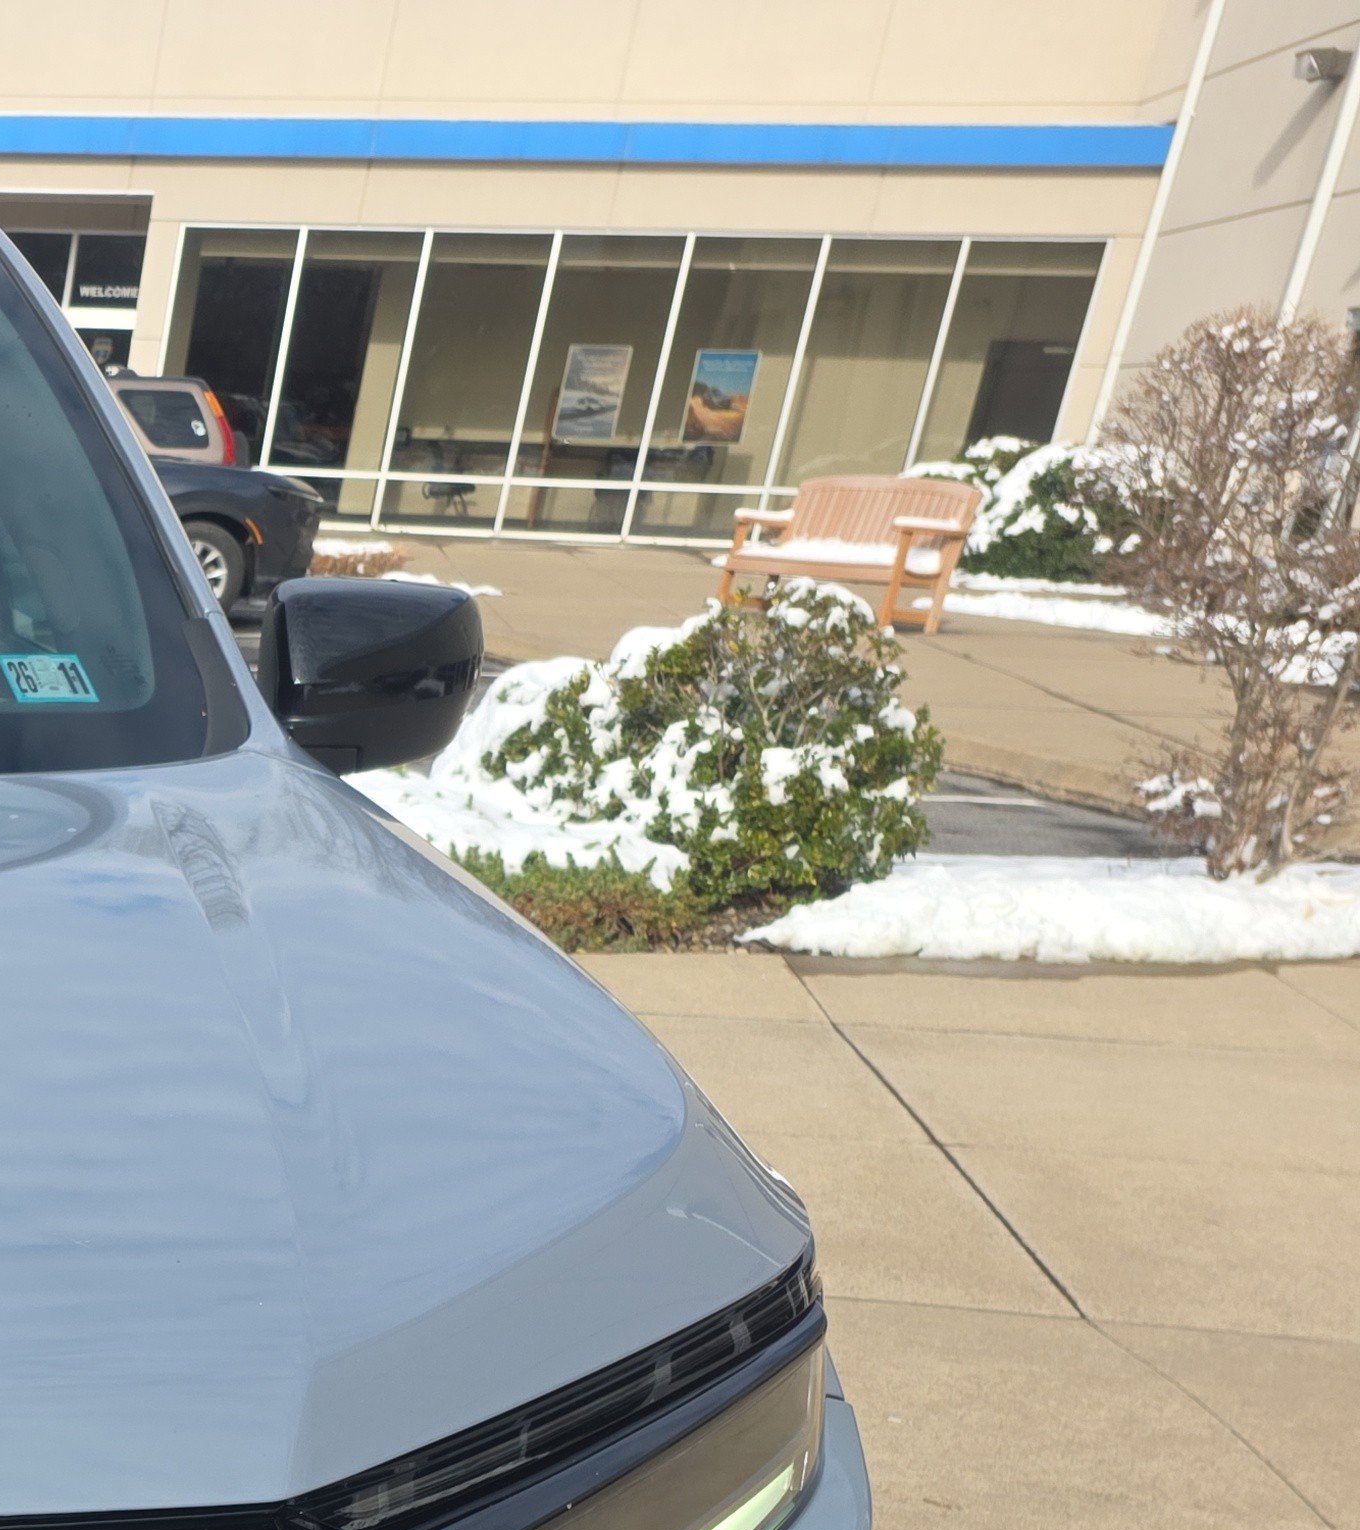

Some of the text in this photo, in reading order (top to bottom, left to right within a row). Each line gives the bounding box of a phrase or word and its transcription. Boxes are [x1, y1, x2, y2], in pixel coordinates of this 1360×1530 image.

[79, 284, 139, 298] WELCOME
[7, 661, 38, 693] 26
[57, 662, 90, 694] 11
